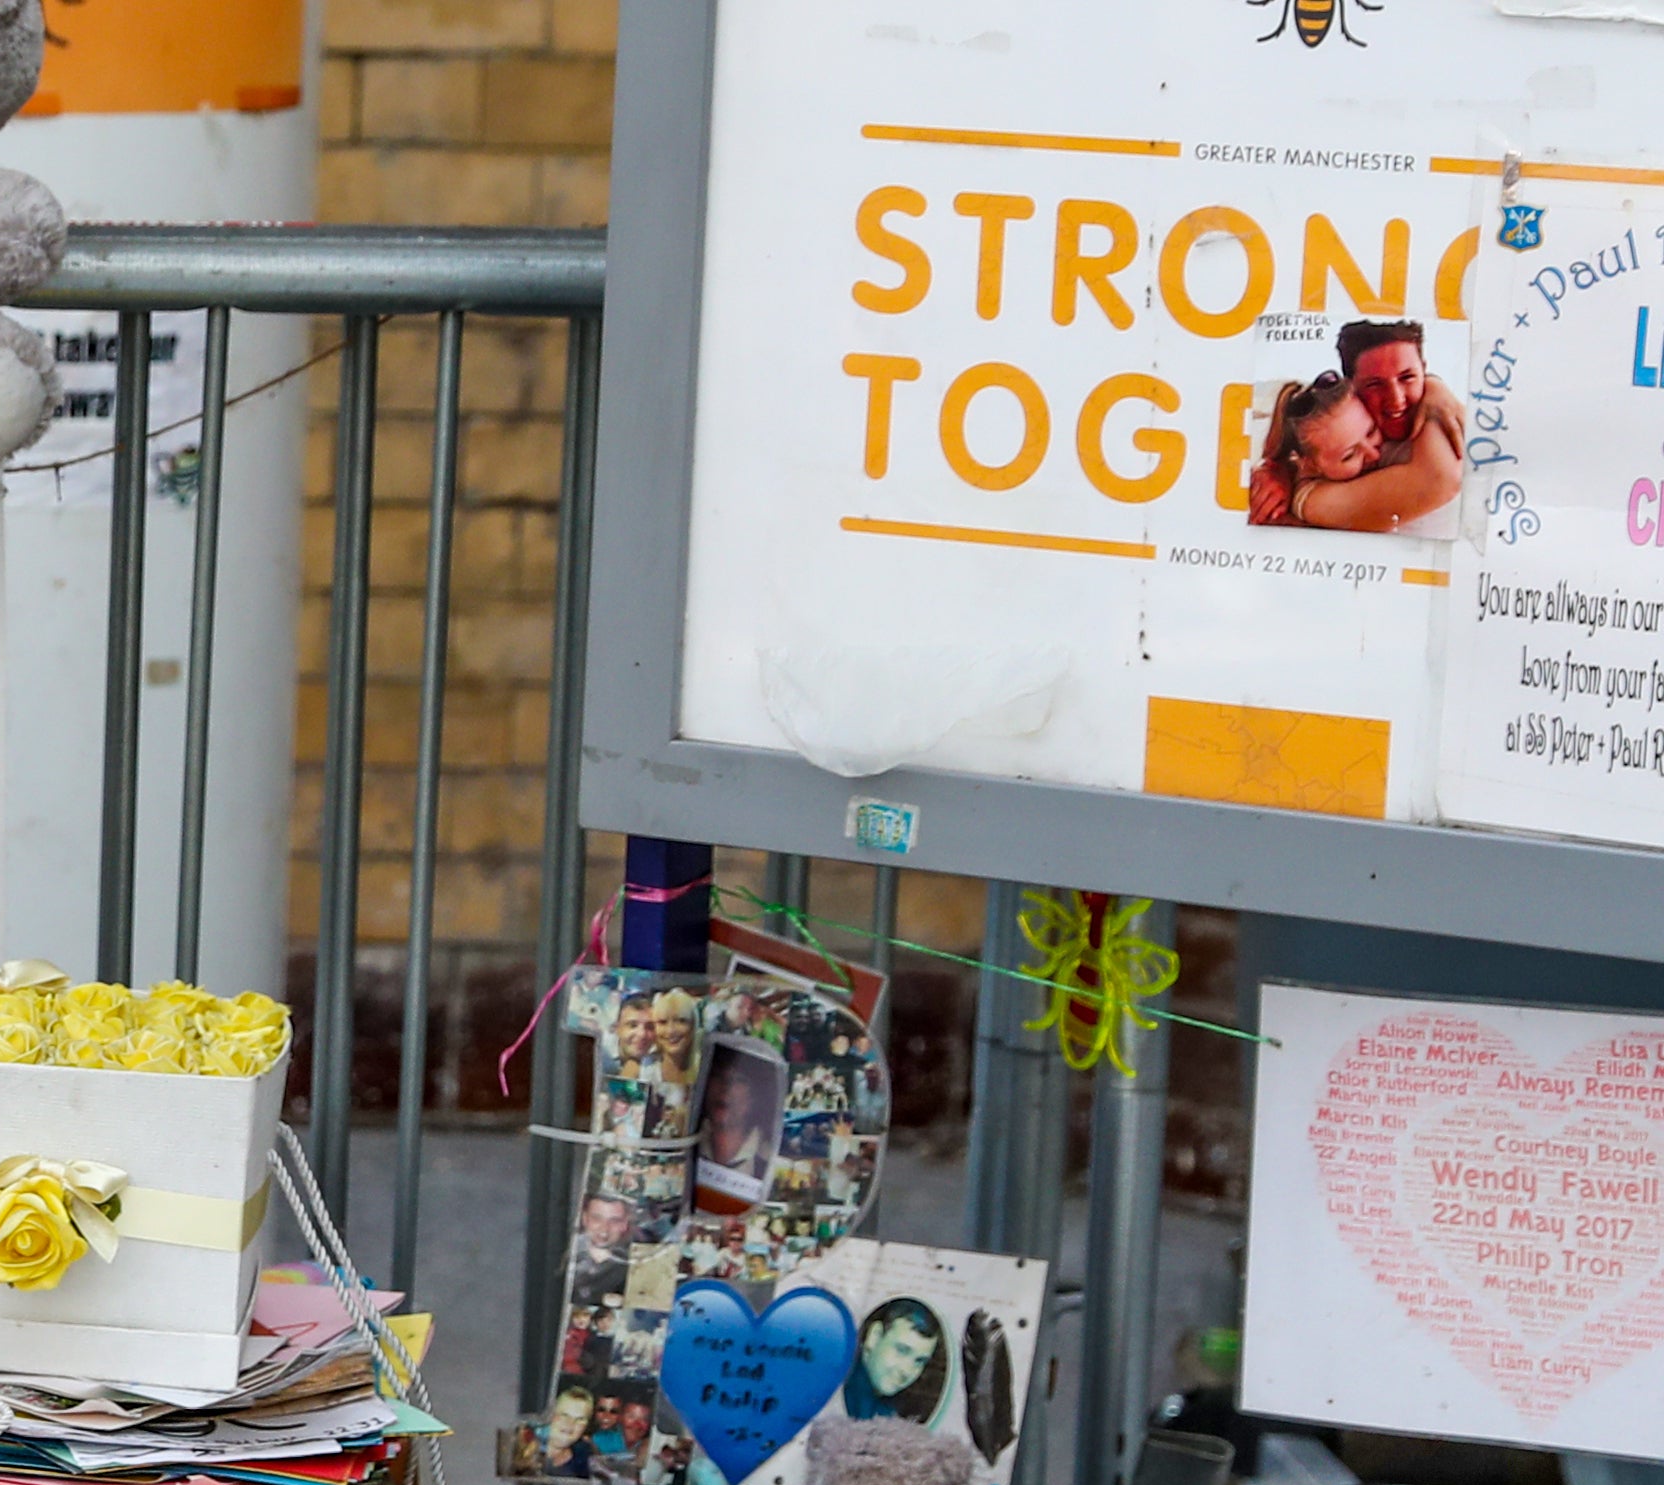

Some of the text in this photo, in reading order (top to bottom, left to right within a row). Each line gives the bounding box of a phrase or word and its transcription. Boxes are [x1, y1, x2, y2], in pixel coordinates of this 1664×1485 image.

[1195, 143, 1415, 172] GREATER MANCHESTER
[1529, 227, 1644, 320] Paul
[1257, 313, 1331, 327] TOGETHER
[1265, 327, 1326, 342] FOREVER
[1170, 546, 1256, 570] MONDAY
[1262, 555, 1287, 574] 22
[1293, 558, 1336, 578] MAY
[1477, 570, 1664, 639] You are allways in our
[1520, 644, 1648, 709] Love from your
[1504, 714, 1522, 753] at
[1524, 711, 1547, 757] SS
[1548, 715, 1595, 767] Peter
[1607, 722, 1649, 774] Paul
[1357, 1037, 1418, 1061] Elaine
[1609, 1039, 1650, 1061] Lisa
[1327, 1070, 1469, 1097] Chloe Rutherford
[1595, 1059, 1647, 1079] Eilidh
[1496, 1070, 1576, 1102] Always
[1494, 1134, 1658, 1171] Courtney Boyle
[1432, 1160, 1660, 1204] Wendy Fawell
[1432, 1202, 1635, 1243] 22nd May 2017
[1476, 1241, 1552, 1277] Philip
[1561, 1250, 1624, 1278] Tron
[1483, 1275, 1595, 1300] Michelle Kiss
[1489, 1351, 1593, 1384] Liam Curry
